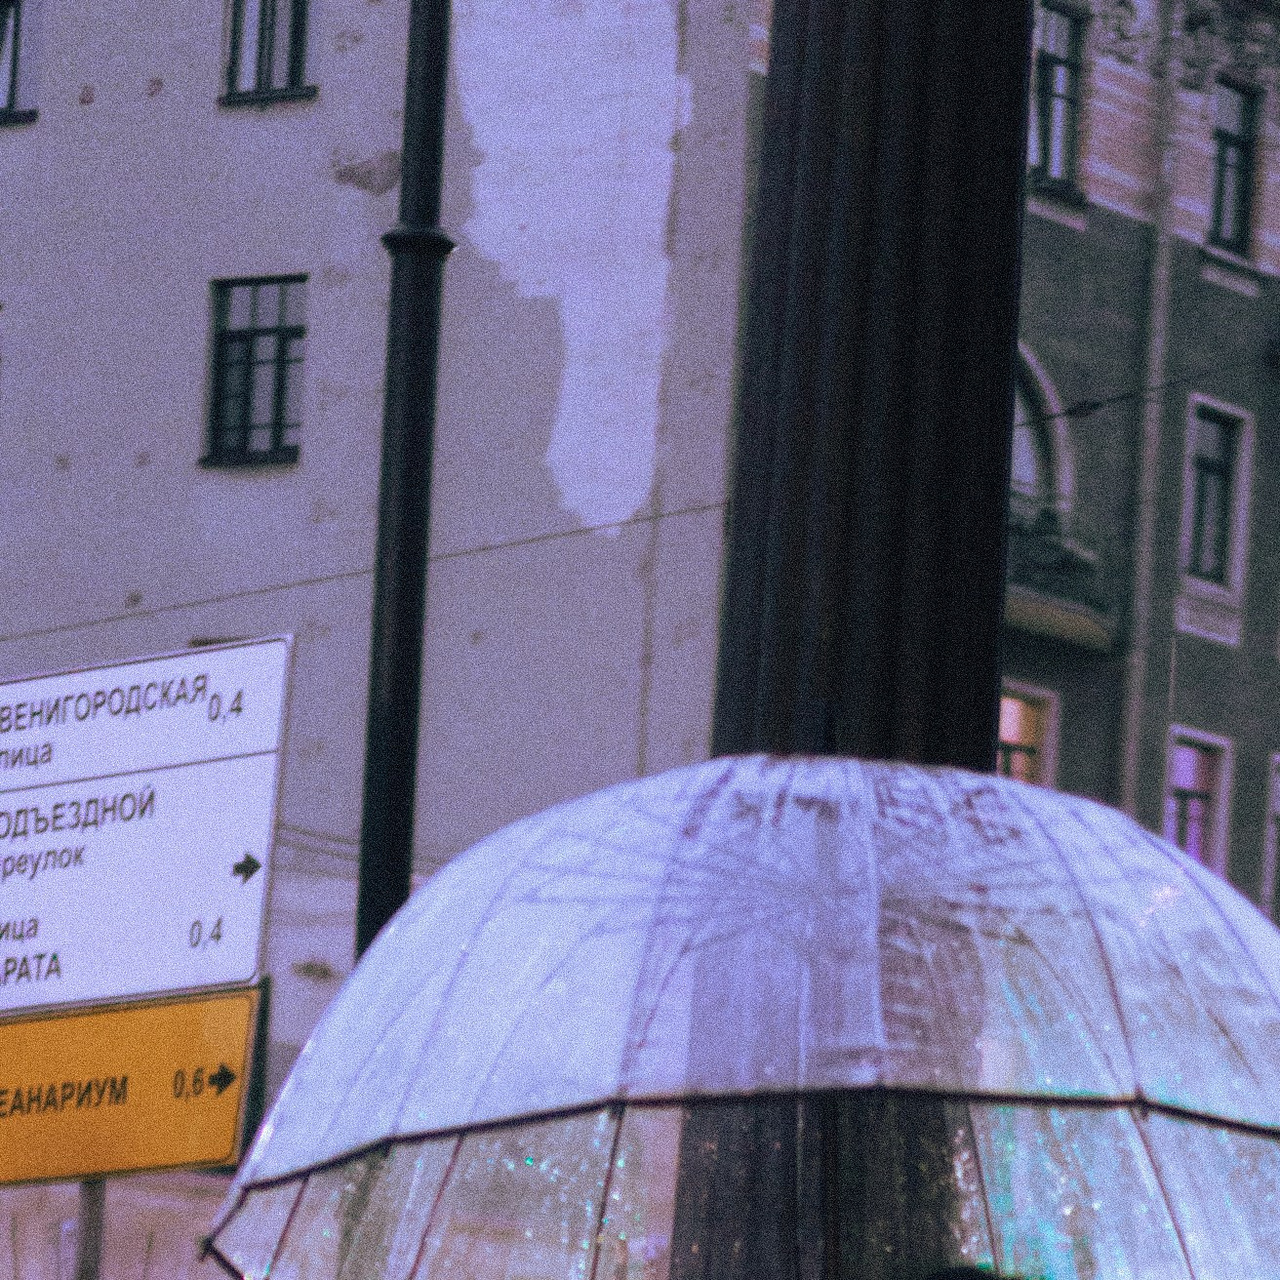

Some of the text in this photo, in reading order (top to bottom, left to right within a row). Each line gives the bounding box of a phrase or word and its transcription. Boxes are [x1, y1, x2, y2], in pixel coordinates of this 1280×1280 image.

[207, 689, 244, 725] 0,4
[189, 915, 223, 949] 0,4
[0, 952, 62, 986] РАТА
[173, 1067, 204, 1102] 0,6
